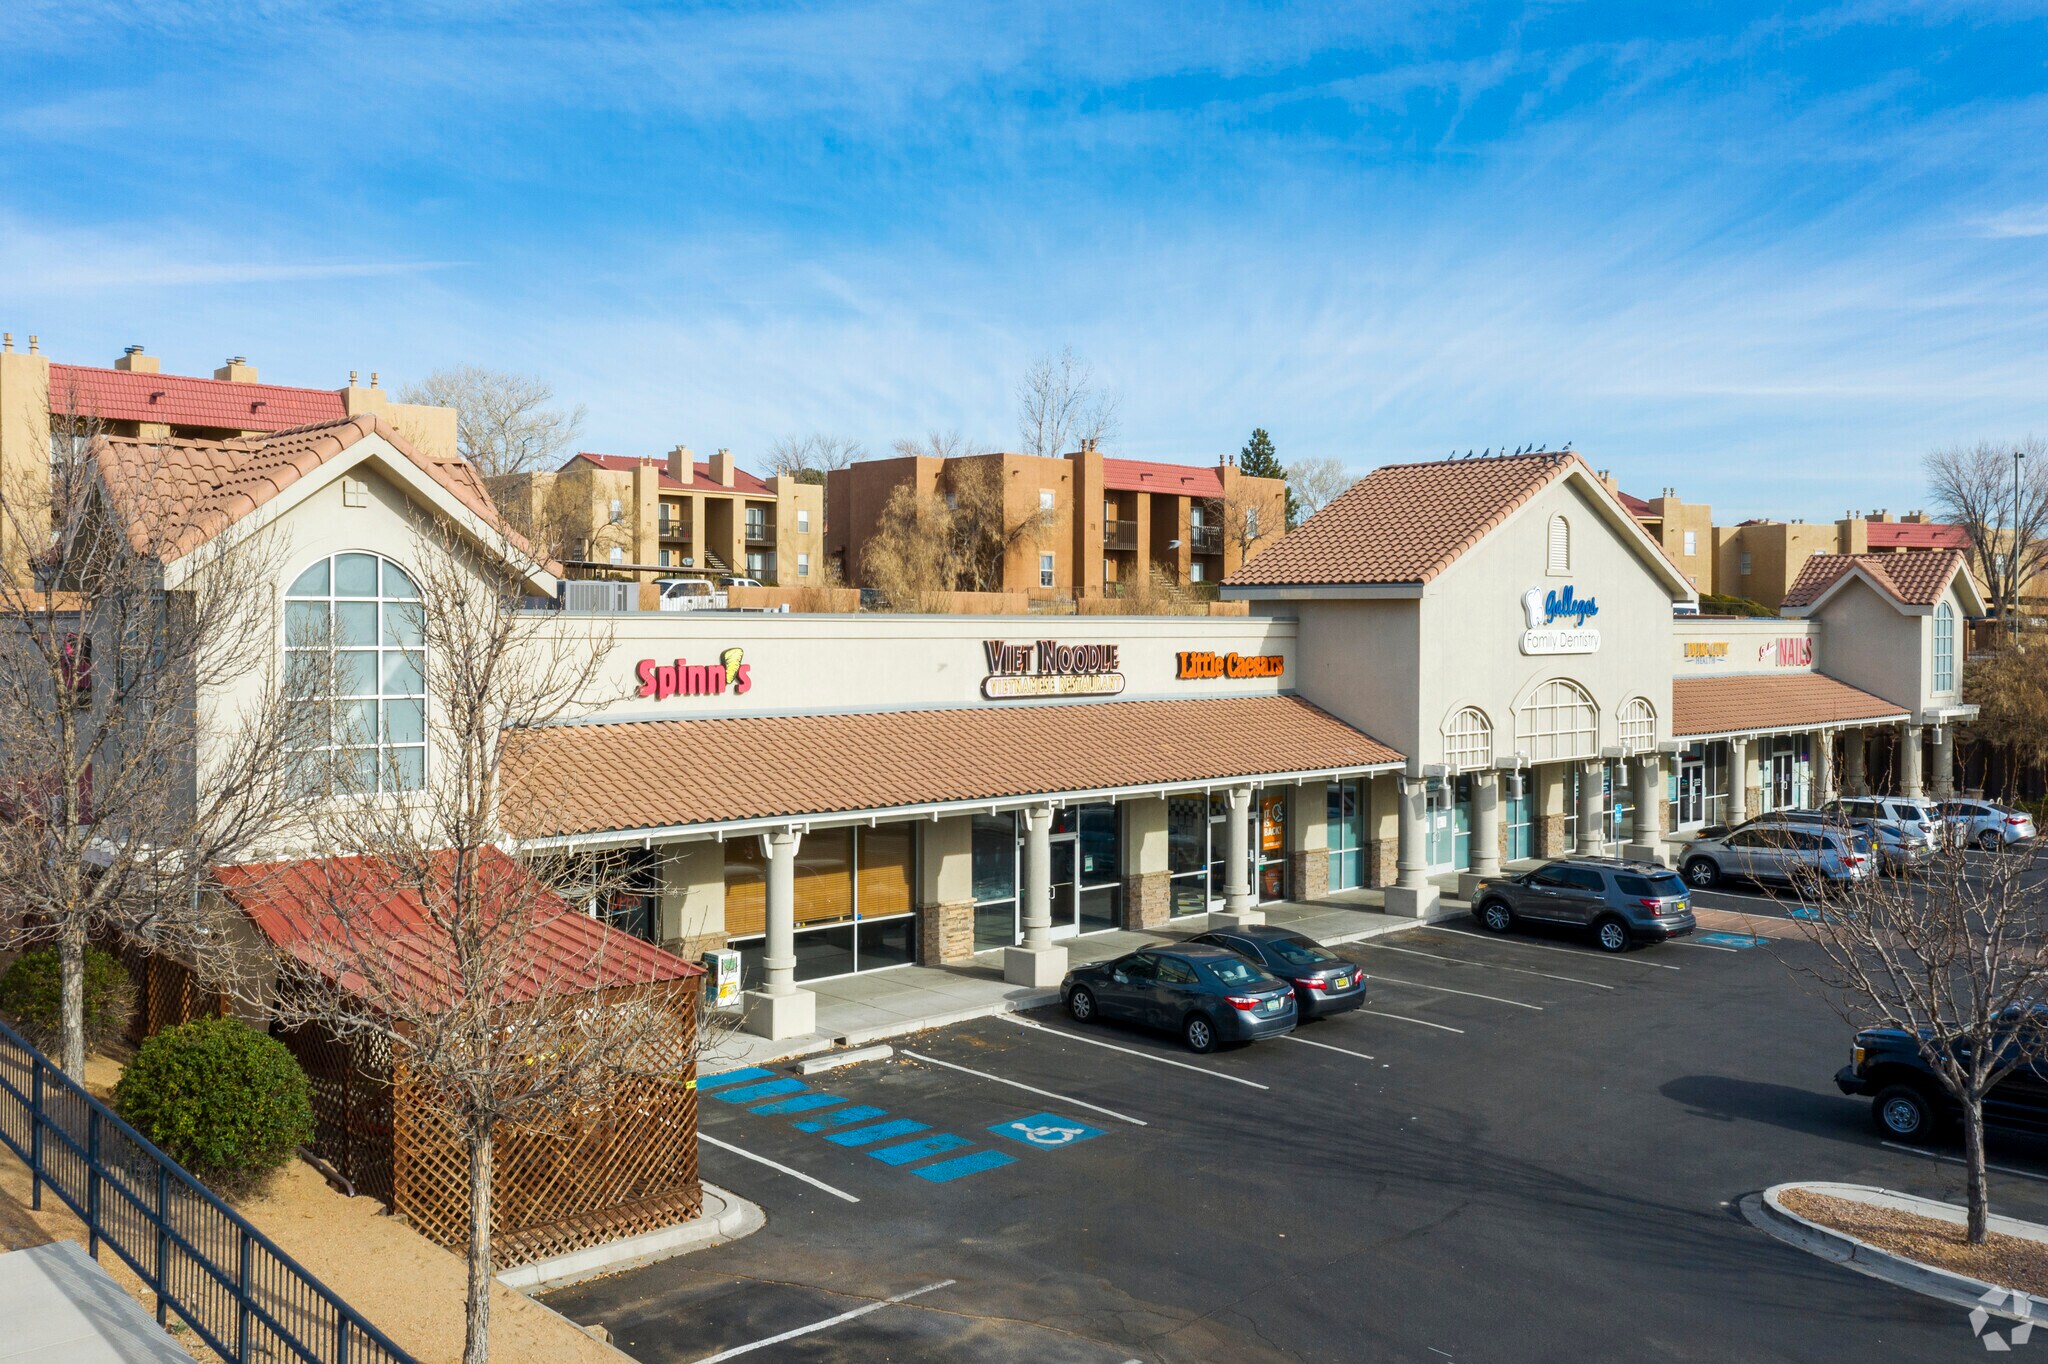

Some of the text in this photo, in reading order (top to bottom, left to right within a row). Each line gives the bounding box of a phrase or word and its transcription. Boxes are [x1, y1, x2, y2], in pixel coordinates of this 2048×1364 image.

[1545, 585, 1599, 626] Gallegos
[1527, 632, 1599, 650] Family Dentistry
[1778, 637, 1812, 665] NAILS
[984, 640, 1120, 673] VIET NOODLE
[1177, 651, 1284, 679] Little Caesars
[990, 675, 1121, 695] VIETNAMESE RESTAURANT
